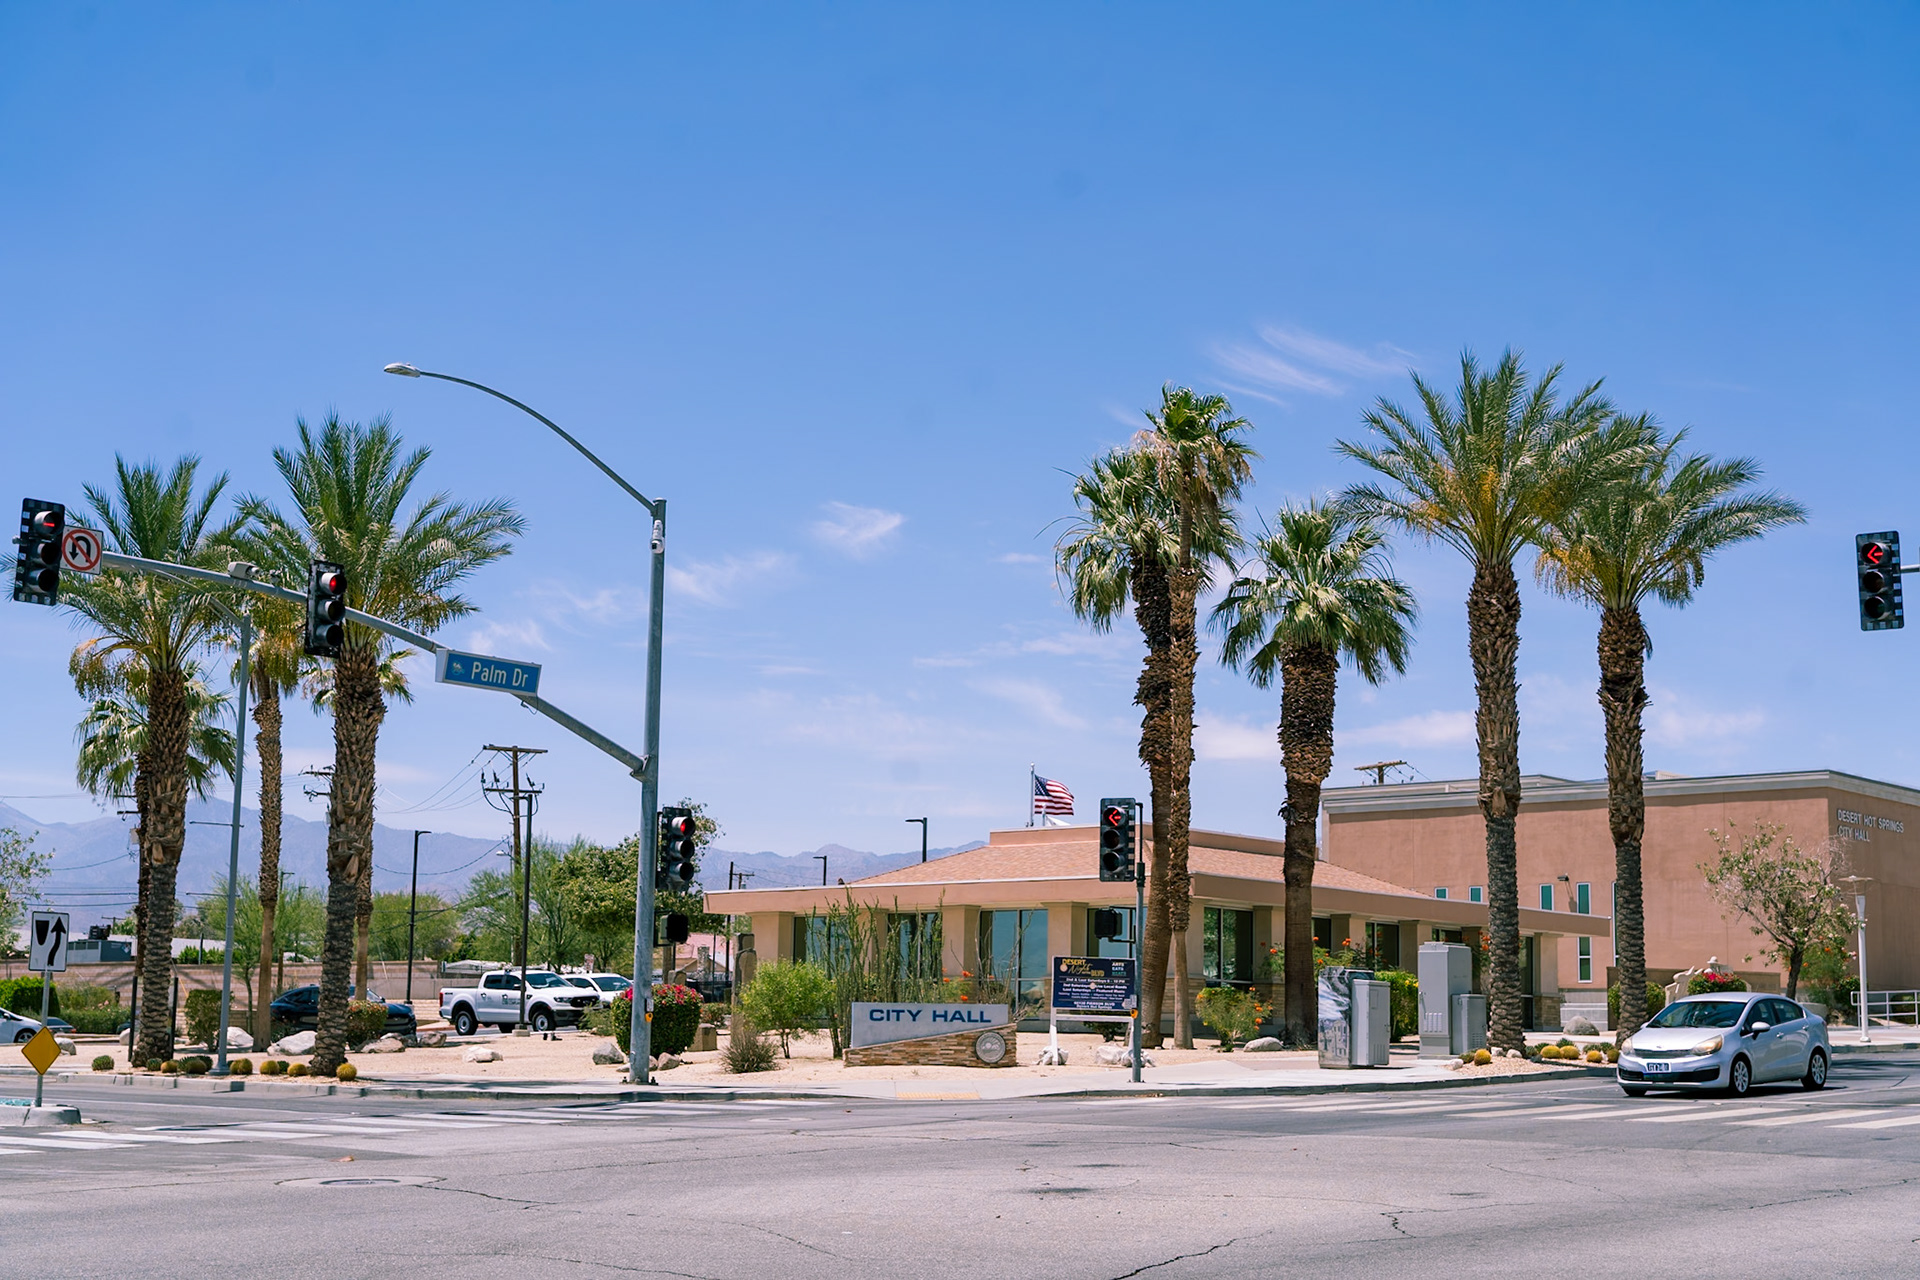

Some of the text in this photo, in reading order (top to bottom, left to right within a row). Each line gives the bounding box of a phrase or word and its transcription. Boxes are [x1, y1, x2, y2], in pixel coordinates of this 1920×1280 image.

[471, 661, 528, 687] Palm Dr
[1837, 809, 1904, 833] DESERT HOT SPRINGS
[1837, 825, 1870, 842] CITY HALL
[869, 1009, 991, 1023] CITY HALL
